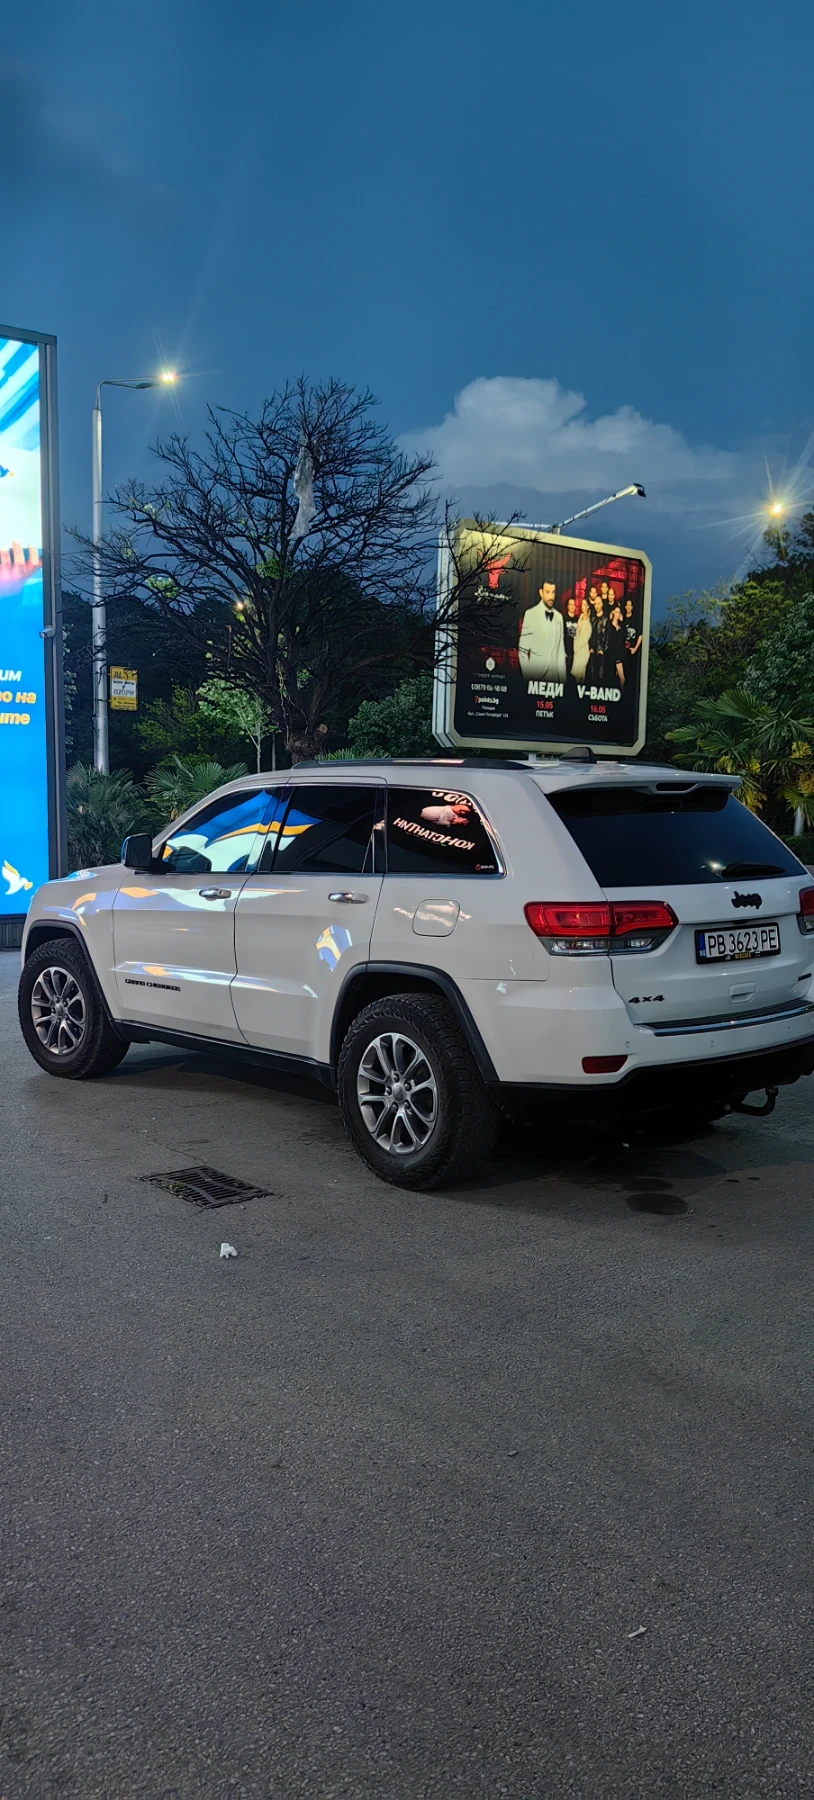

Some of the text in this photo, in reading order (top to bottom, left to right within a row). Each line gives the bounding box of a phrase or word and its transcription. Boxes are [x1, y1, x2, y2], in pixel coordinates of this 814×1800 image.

[527, 680, 564, 699] МЕДИ
[577, 685, 621, 702] V-BAND
[536, 700, 554, 710] 15.05
[590, 705, 606, 714] 16.05
[535, 710, 554, 718] ПЕТЪК
[587, 713, 608, 722] СЪБОТА
[707, 928, 777, 956] PB 3623 PE
